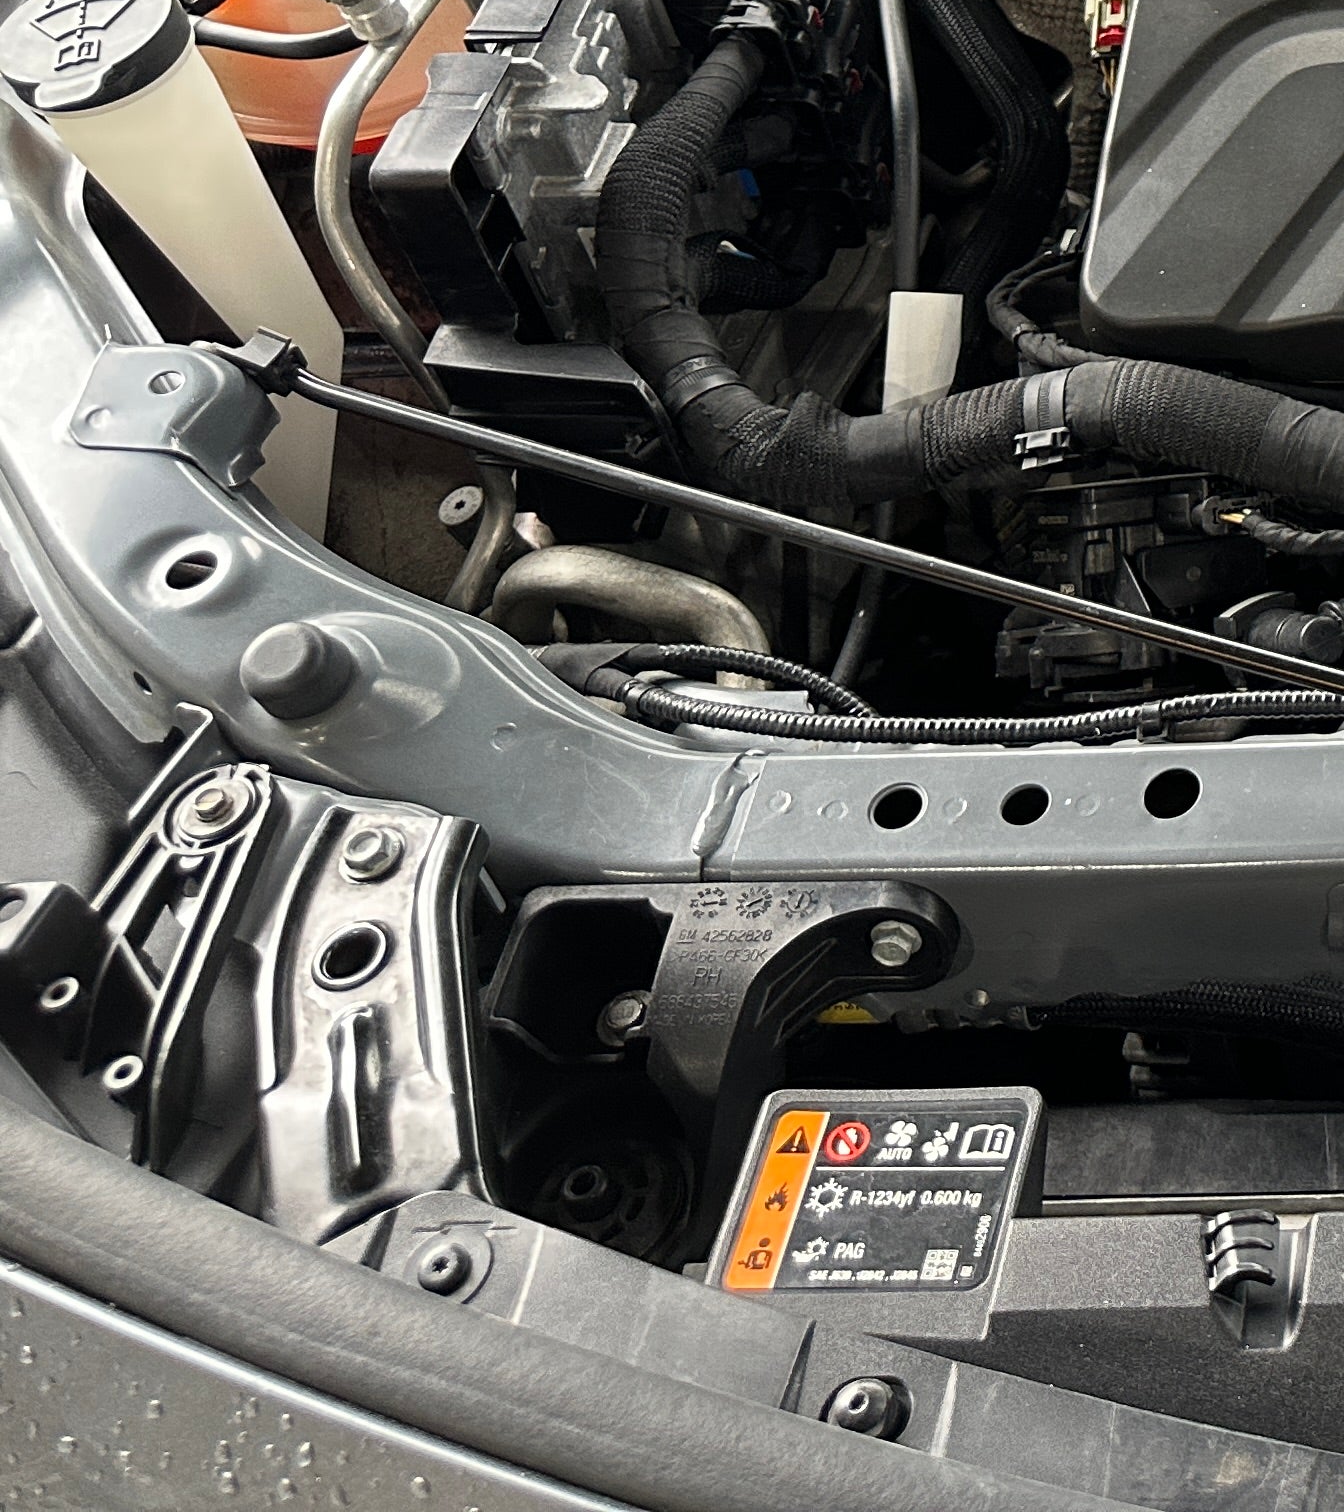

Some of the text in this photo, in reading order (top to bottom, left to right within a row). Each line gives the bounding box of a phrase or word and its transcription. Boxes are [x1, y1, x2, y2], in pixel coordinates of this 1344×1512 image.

[877, 1147, 913, 1161] AUTO
[849, 1190, 983, 1208] R-1234yf 0.600 kg
[832, 1243, 865, 1259] PAG
